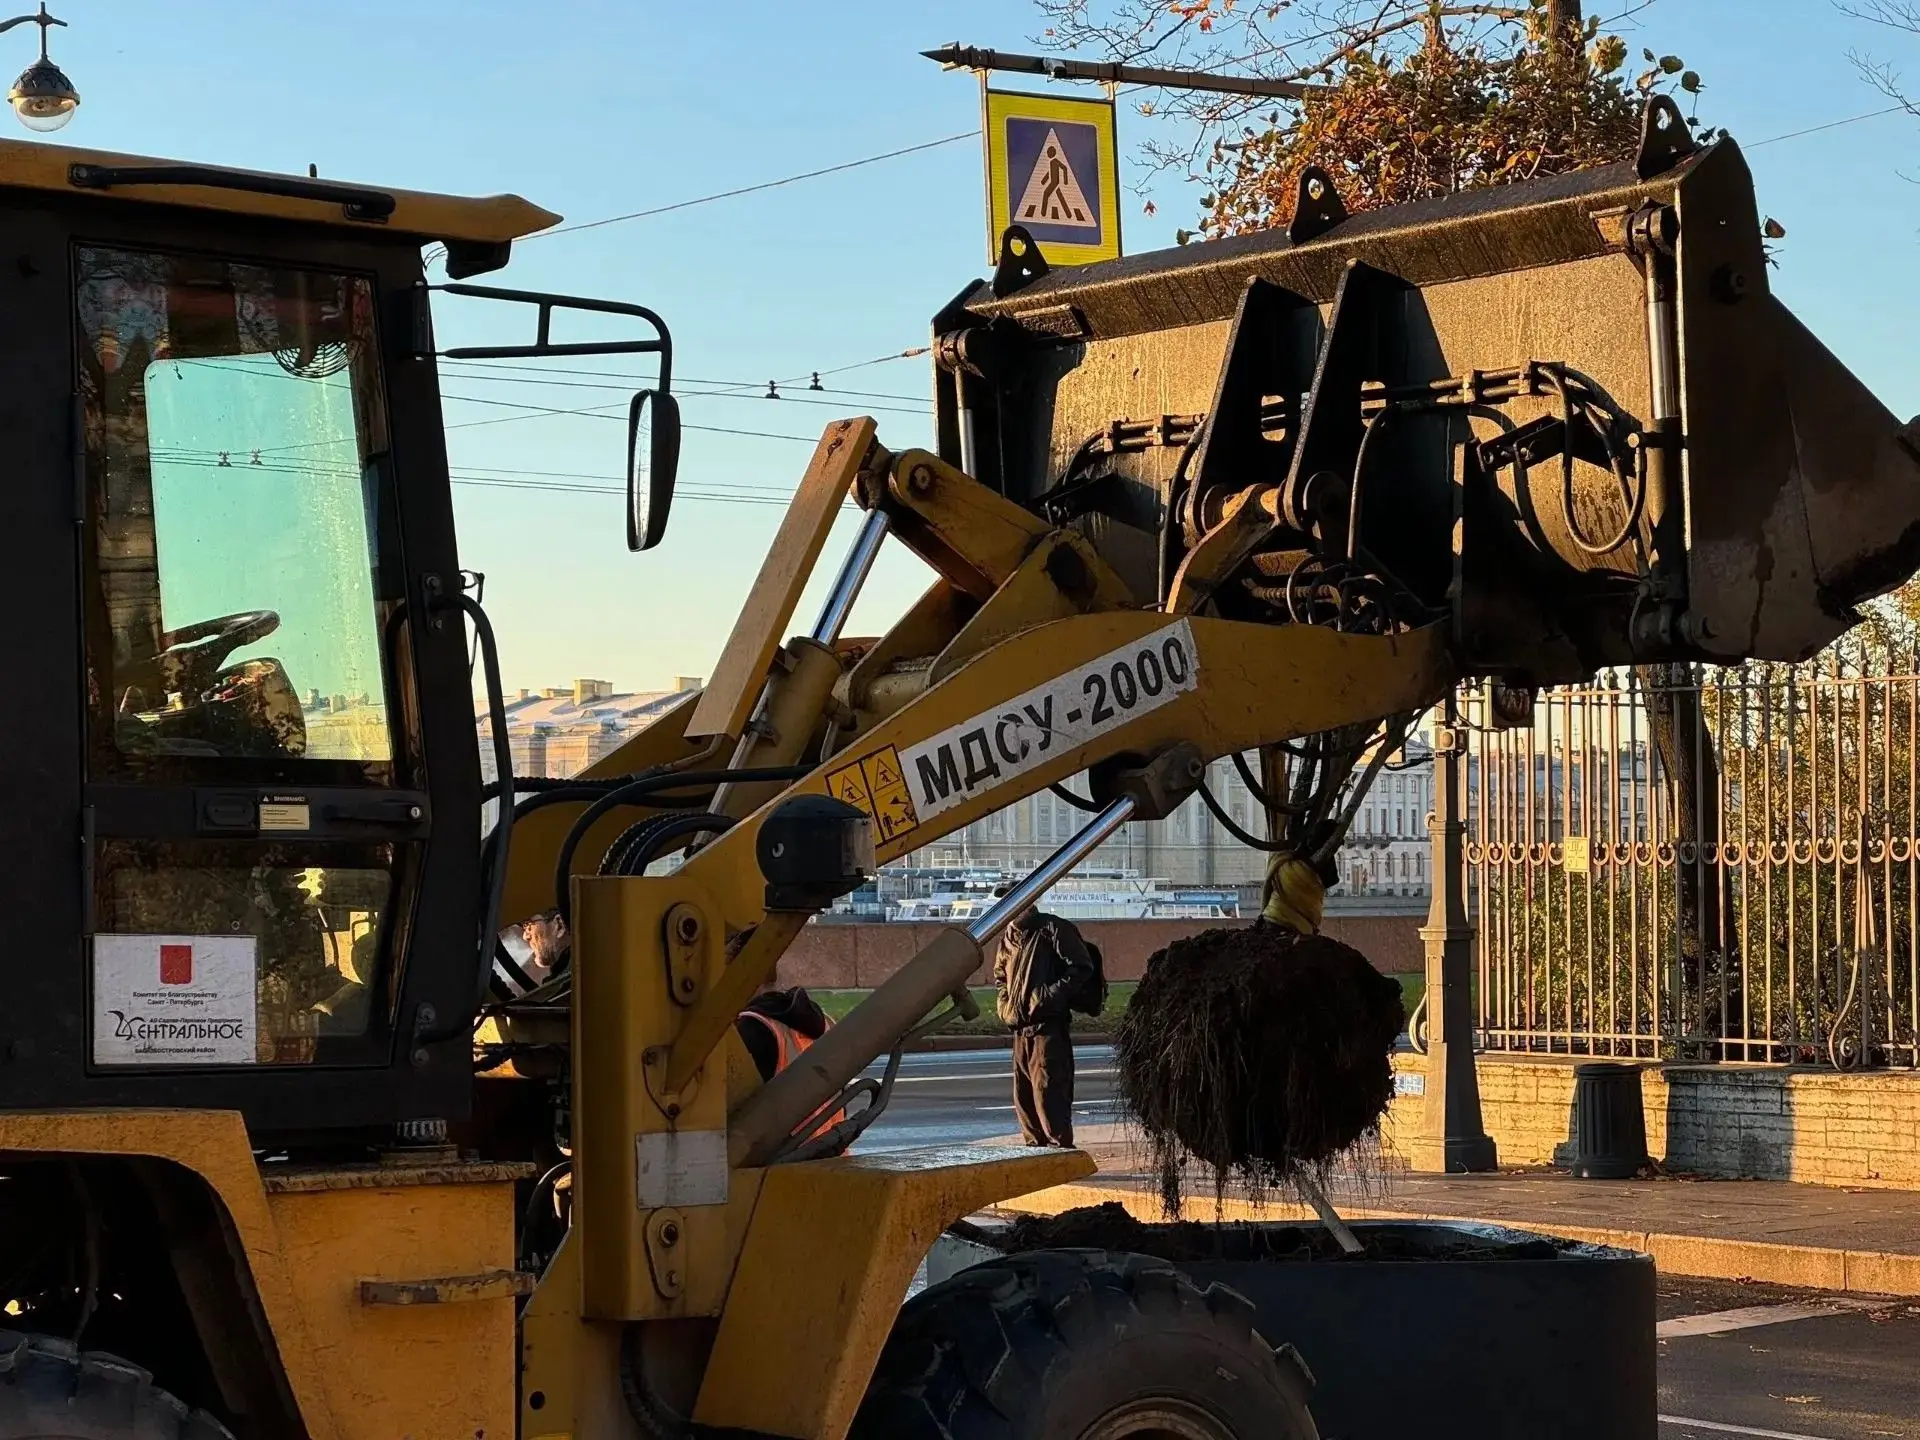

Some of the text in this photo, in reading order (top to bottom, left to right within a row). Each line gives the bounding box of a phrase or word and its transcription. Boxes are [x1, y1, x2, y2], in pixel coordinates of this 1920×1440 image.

[914, 636, 1190, 806] МДСУ-2000
[167, 991, 218, 999] благоустройству
[169, 998, 204, 1006] Петербурга
[107, 1010, 243, 1041] ЦЕНТРАЛЬНОЕ
